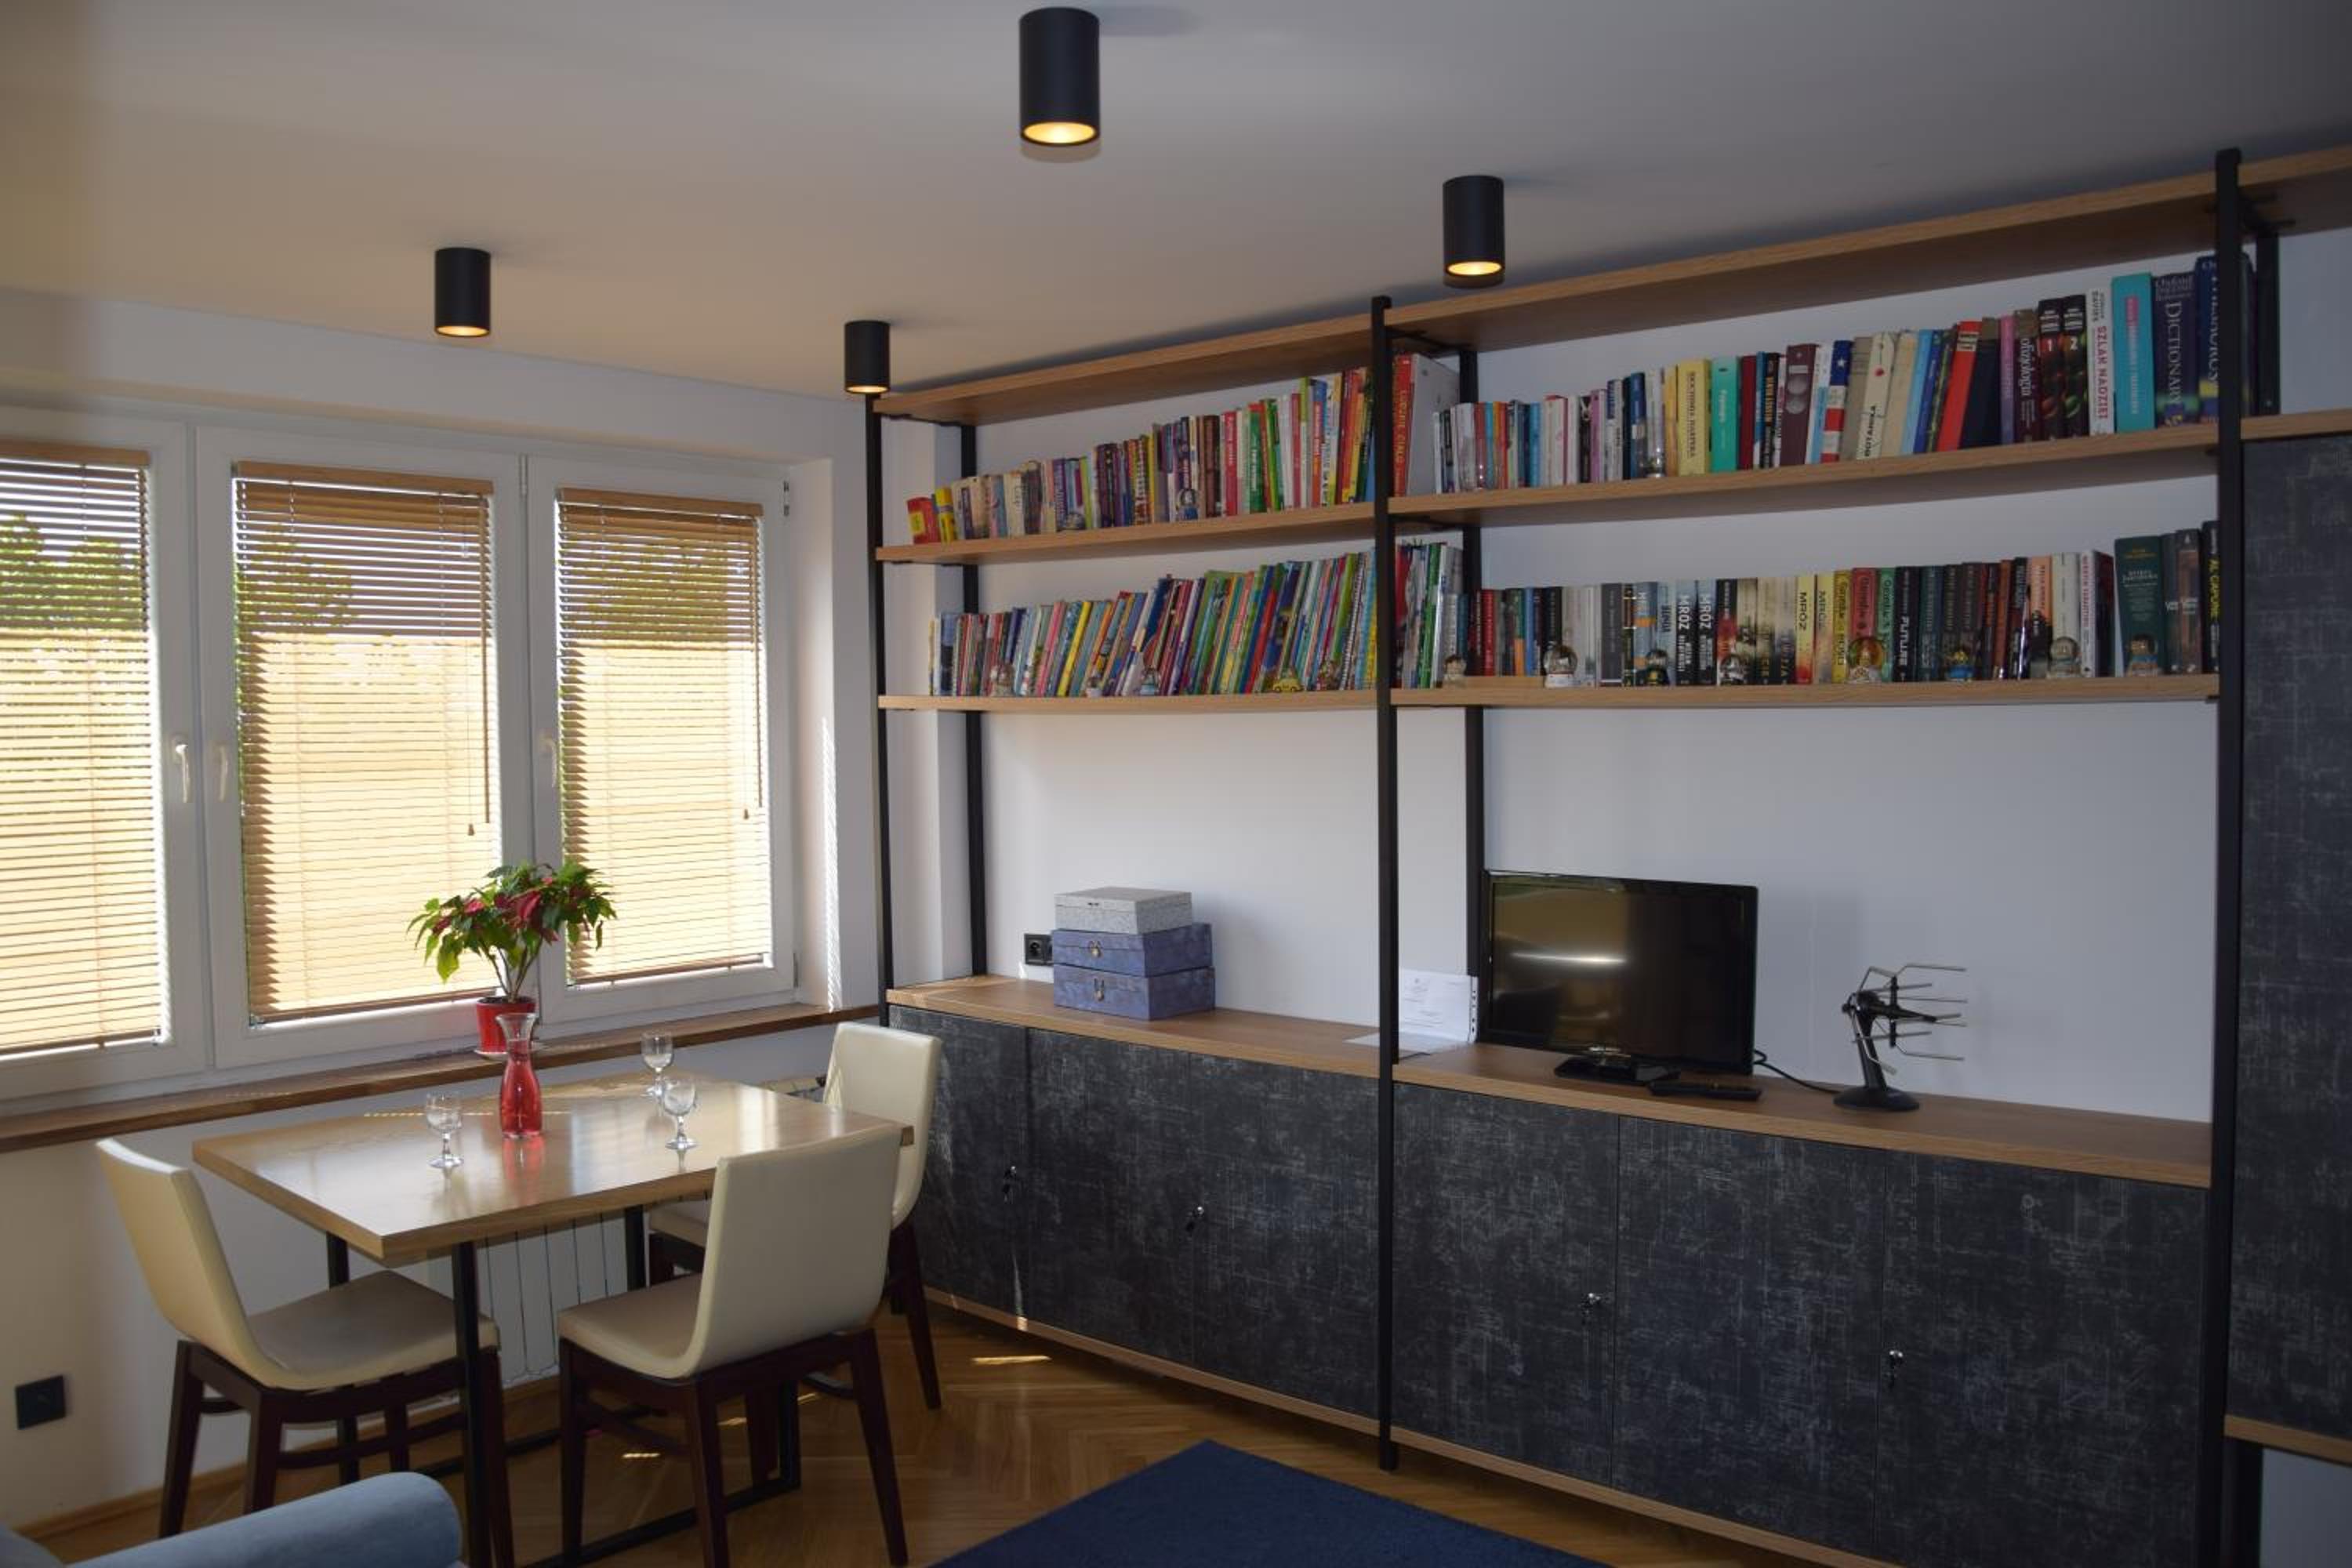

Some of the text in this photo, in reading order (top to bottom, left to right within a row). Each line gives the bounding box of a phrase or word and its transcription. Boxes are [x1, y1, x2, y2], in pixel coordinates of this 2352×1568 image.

[2046, 339, 2053, 352] 1
[2070, 336, 2078, 350] 2
[2165, 301, 2183, 405] DICTIONARY
[2097, 326, 2108, 419] SZLAK NADZIEI
[1864, 405, 1876, 457] BOTANIKA
[1678, 593, 1690, 630] MRÓZ
[1699, 593, 1711, 630] MRÓZ
[1798, 592, 1809, 631] MRÓZ
